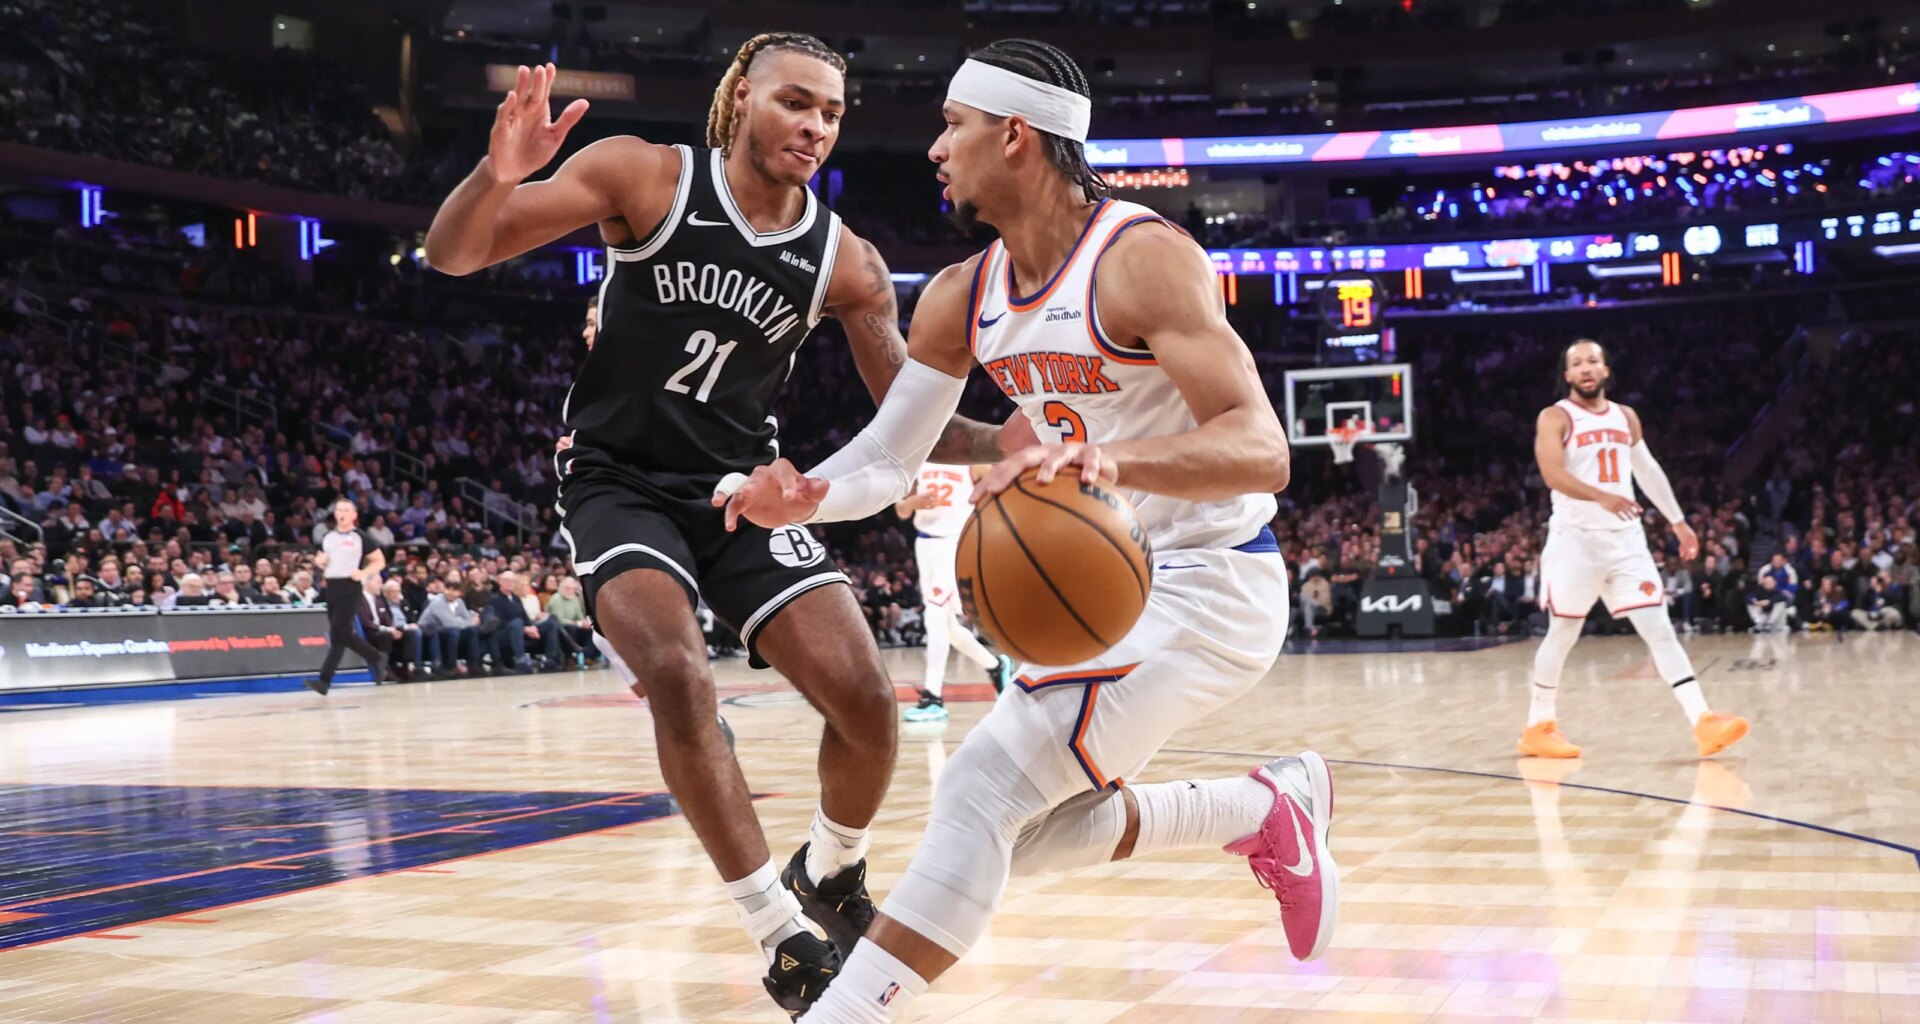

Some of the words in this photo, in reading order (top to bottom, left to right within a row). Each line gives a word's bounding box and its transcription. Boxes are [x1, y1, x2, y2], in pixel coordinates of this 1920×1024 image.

[779, 250, 792, 263] All
[790, 254, 800, 267] In
[799, 257, 817, 274] Won
[653, 261, 800, 344] BROOKLYN
[1045, 312, 1060, 321] abu
[1060, 309, 1082, 320] dhabi
[1343, 298, 1372, 328] 19
[663, 329, 739, 403] 21
[1029, 351, 1121, 394] YORK
[1597, 447, 1620, 483] 11
[784, 529, 813, 562] B
[80, 640, 126, 657] Square
[124, 638, 169, 654] Garden
